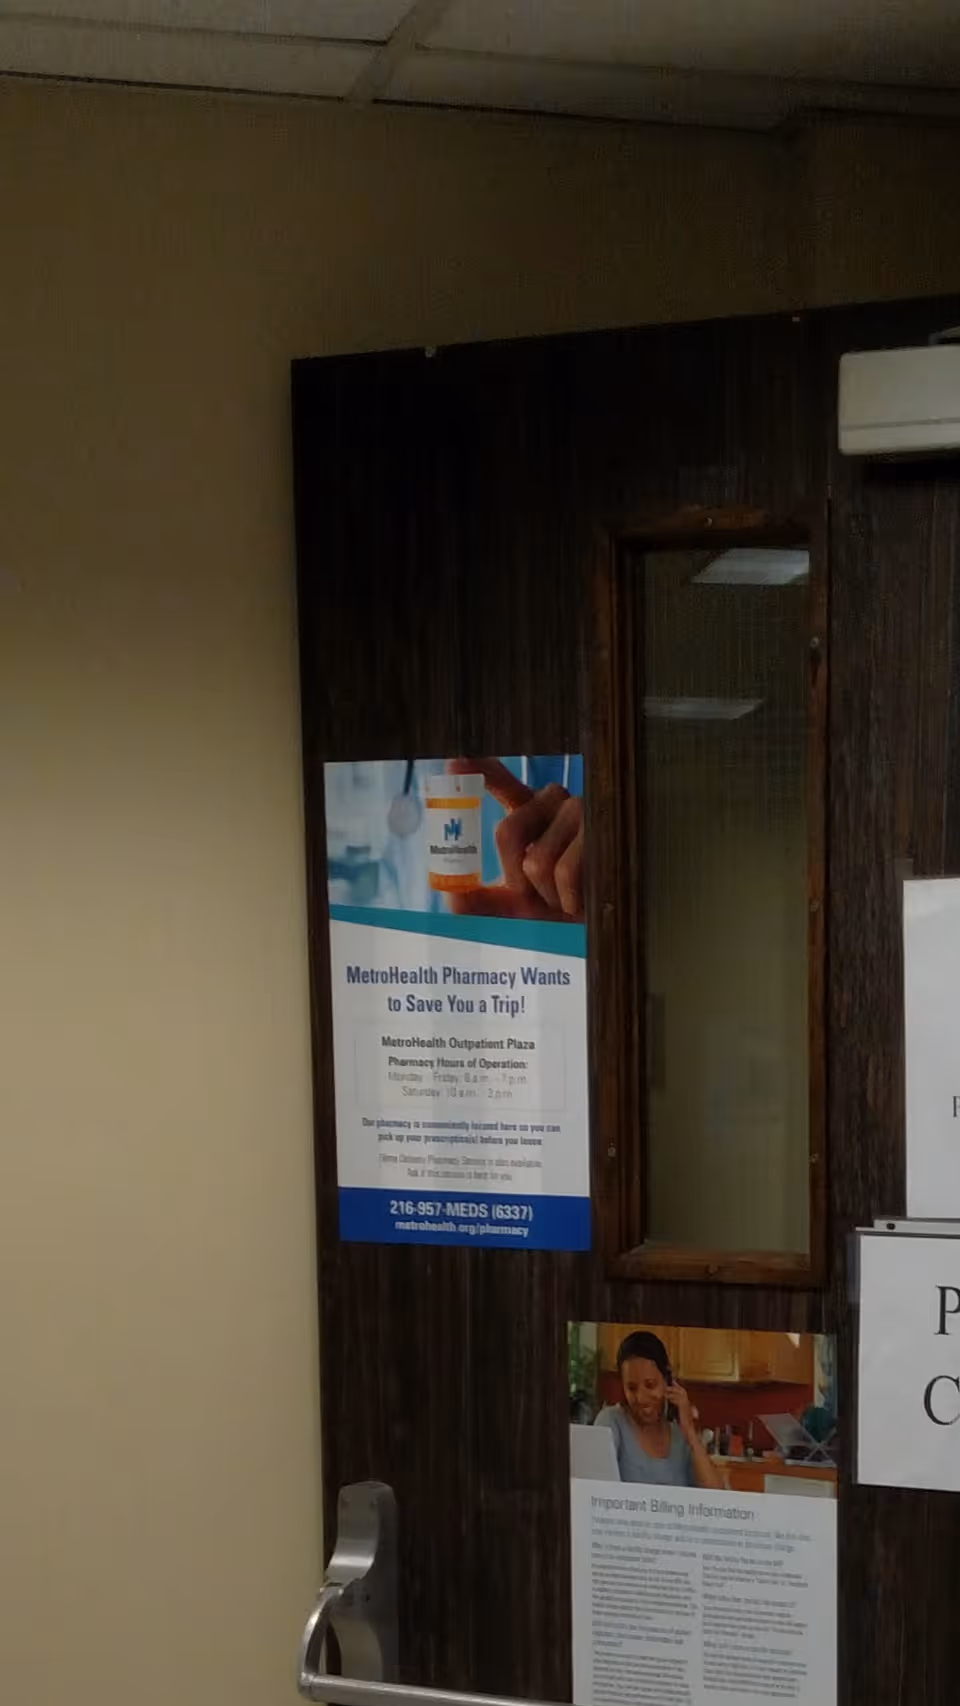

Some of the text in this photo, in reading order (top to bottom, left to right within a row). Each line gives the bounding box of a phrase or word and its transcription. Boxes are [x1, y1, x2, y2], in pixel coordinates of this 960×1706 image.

[346, 966, 571, 989] MetroHealth Pharmacy Wants
[387, 995, 526, 1017] to Save You a Trip!
[381, 1036, 536, 1051] MetroHealth Outpatient Plaza
[388, 1057, 528, 1072] Pharmacy Hours of Operation:
[390, 1200, 533, 1222] 216-957-MEDS (6337)
[395, 1220, 530, 1238] metrohealth.org/pharmacy
[590, 1495, 755, 1521] Important Billing Information
